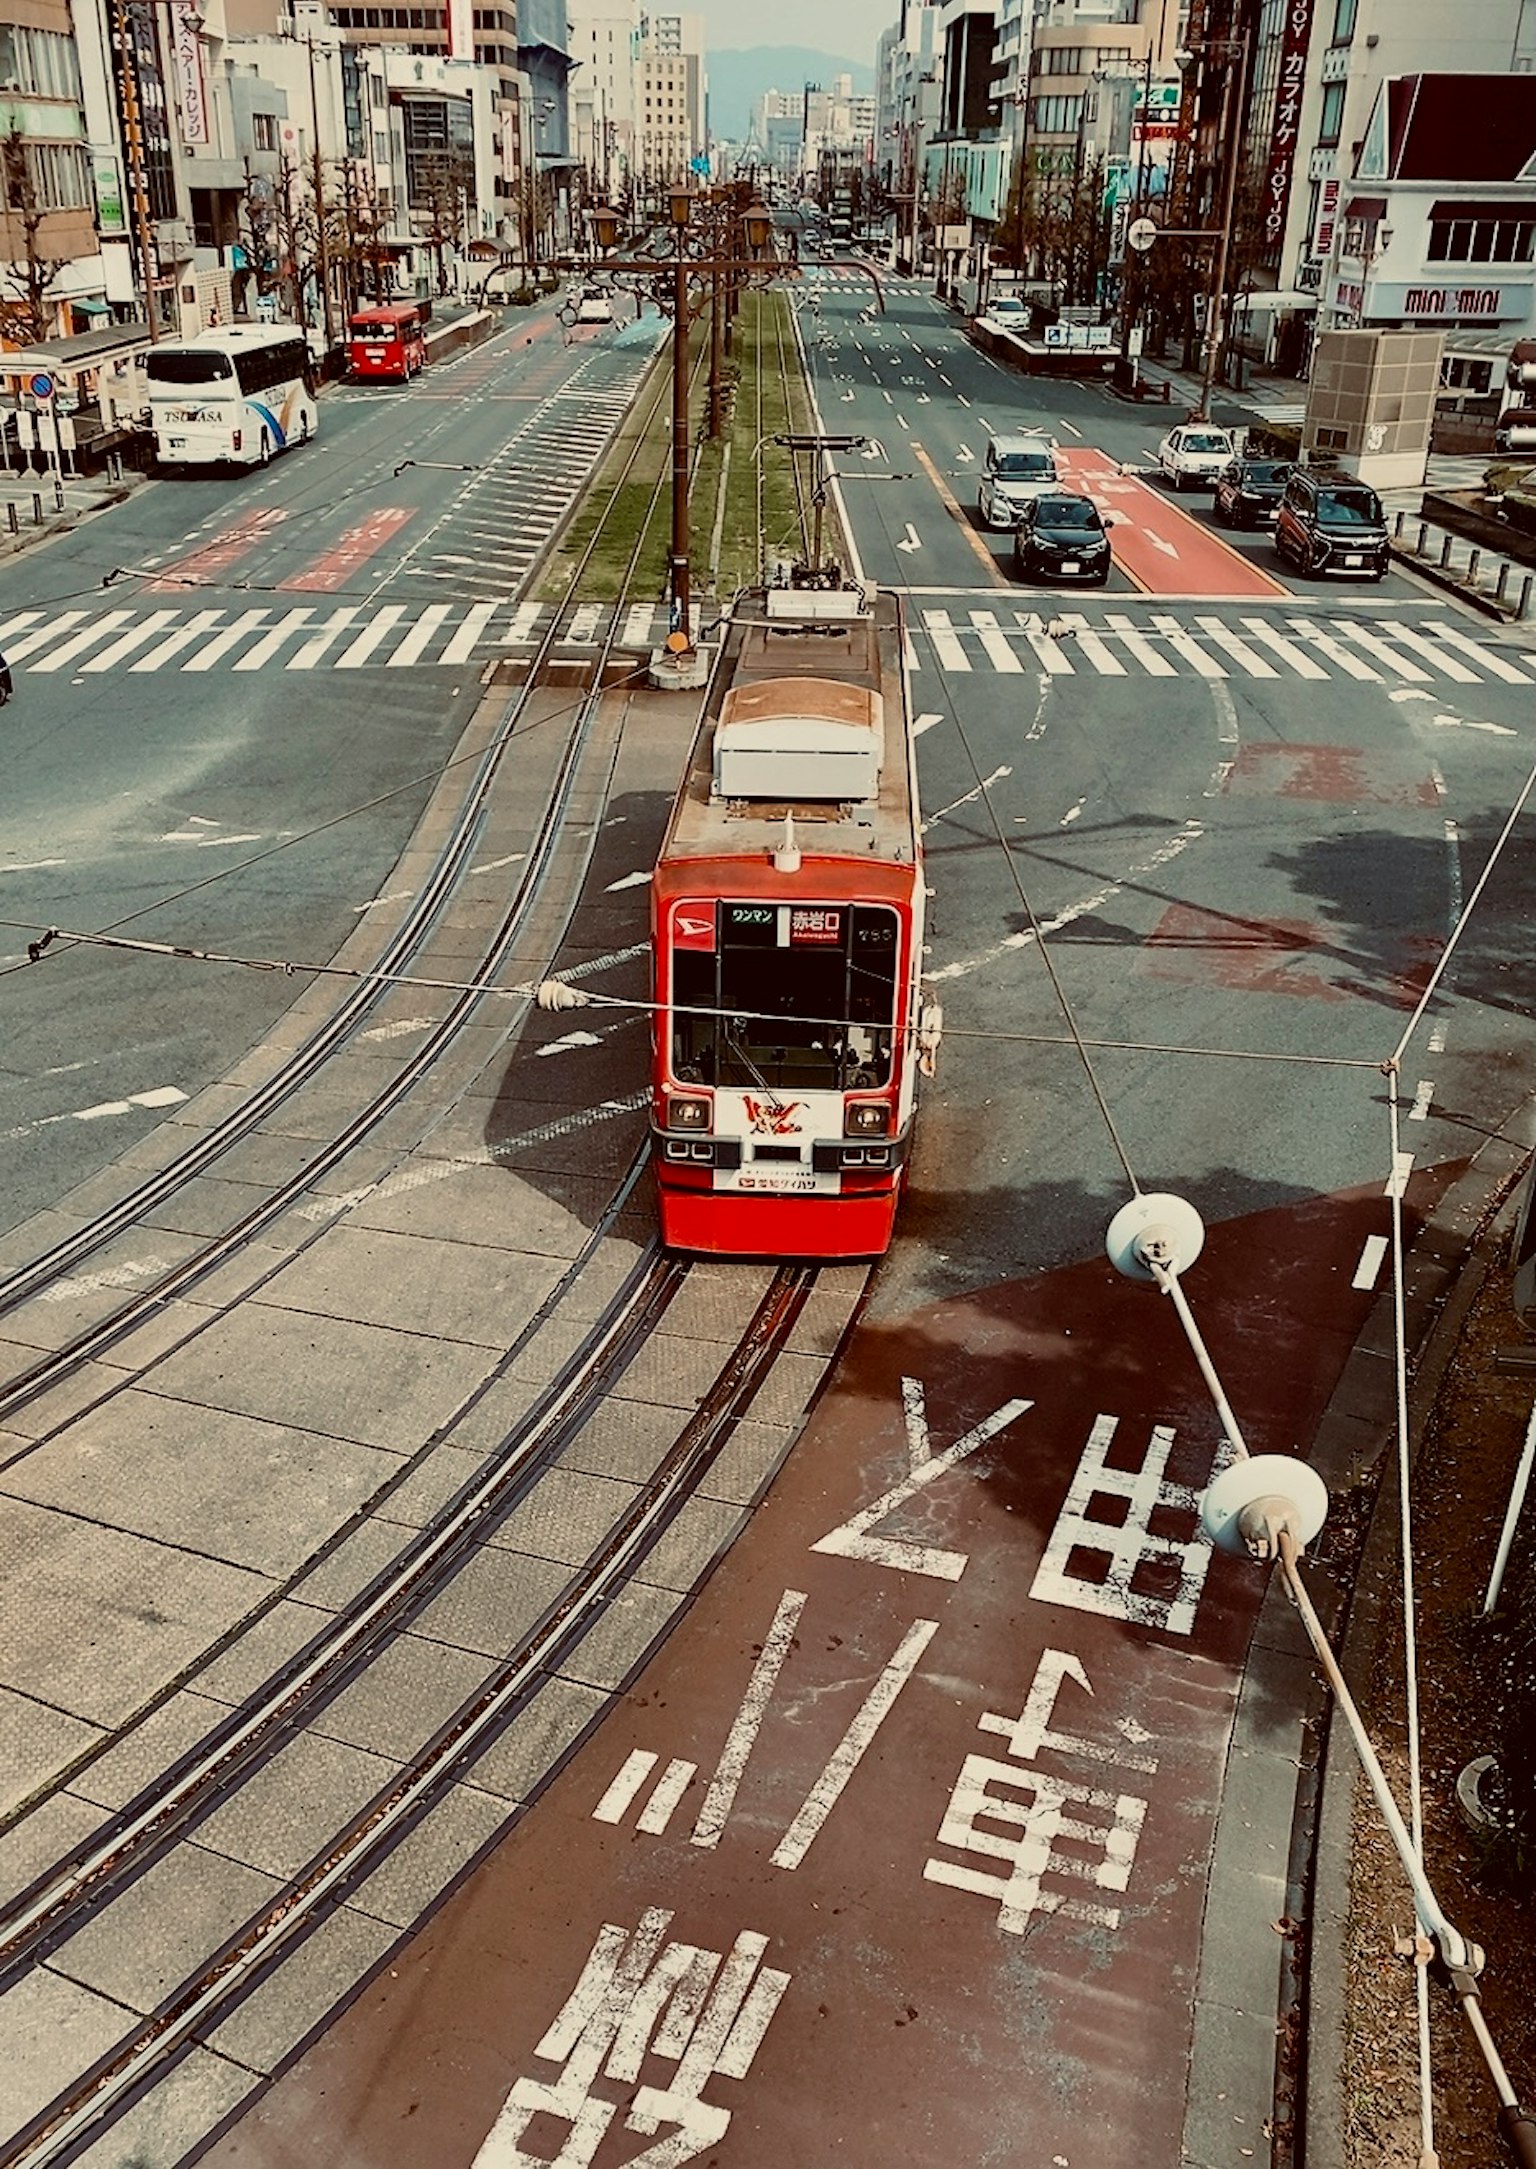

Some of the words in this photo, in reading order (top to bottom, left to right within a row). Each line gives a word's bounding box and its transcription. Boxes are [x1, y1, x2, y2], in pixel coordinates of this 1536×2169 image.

[1276, 51, 1304, 145] カラオケ
[164, 411, 223, 423] TSUASA
[732, 909, 773, 923] ワンマン
[792, 911, 840, 931] 赤岩口
